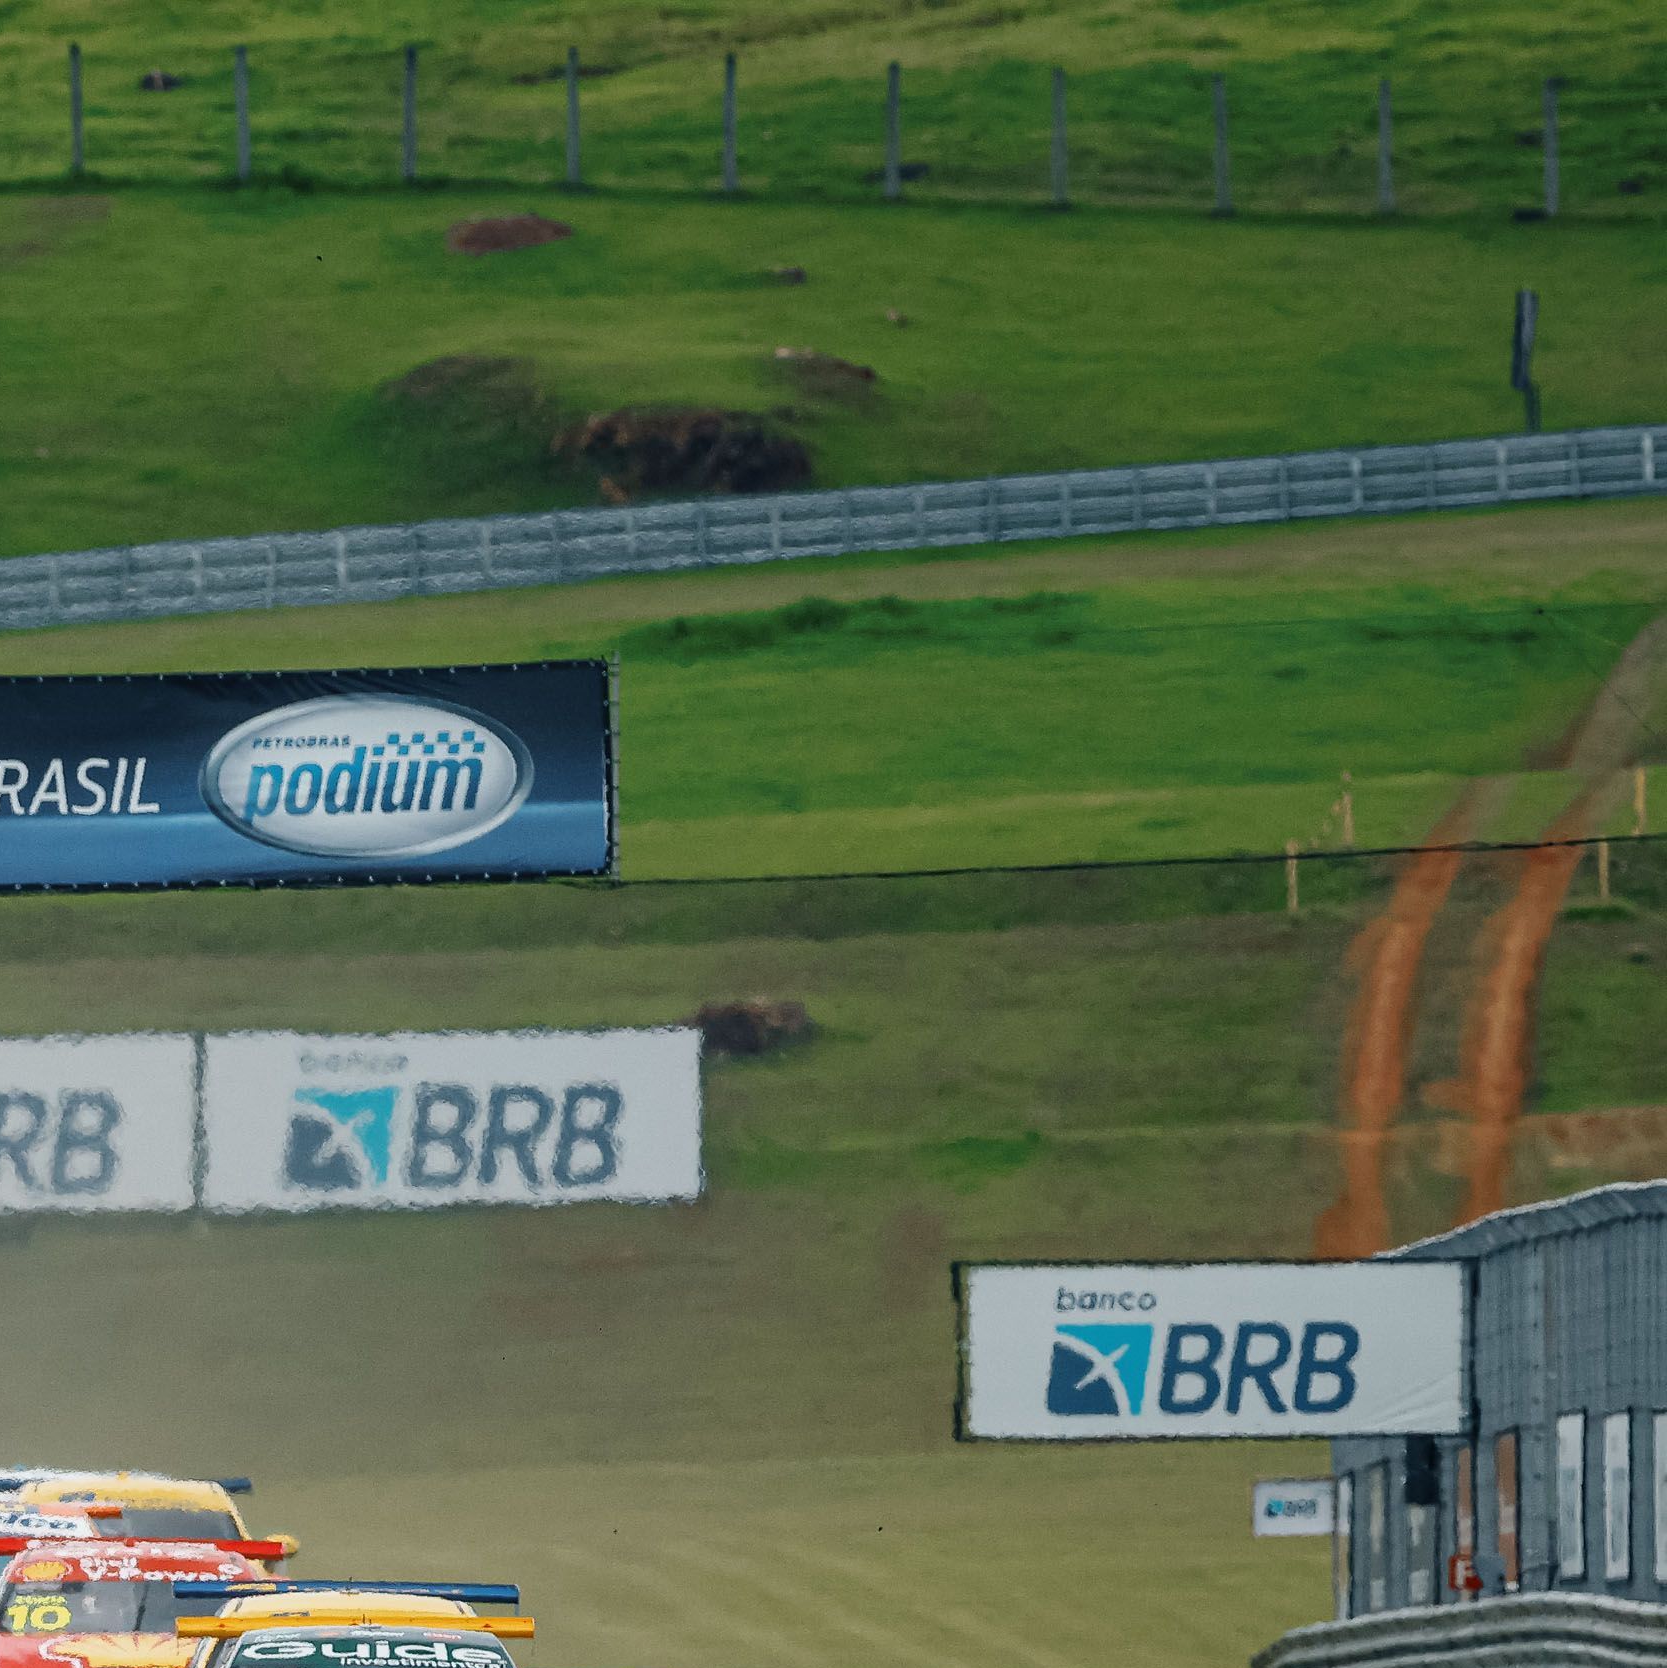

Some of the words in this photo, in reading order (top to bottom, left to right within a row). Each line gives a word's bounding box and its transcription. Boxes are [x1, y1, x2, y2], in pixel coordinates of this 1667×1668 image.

[252, 733, 351, 751] PETROBRAS
[243, 748, 484, 827] podium
[407, 1082, 623, 1188] BRB
[1056, 1287, 1156, 1311] banco
[1158, 1321, 1360, 1415] BRB
[242, 1640, 502, 1663] Guide
